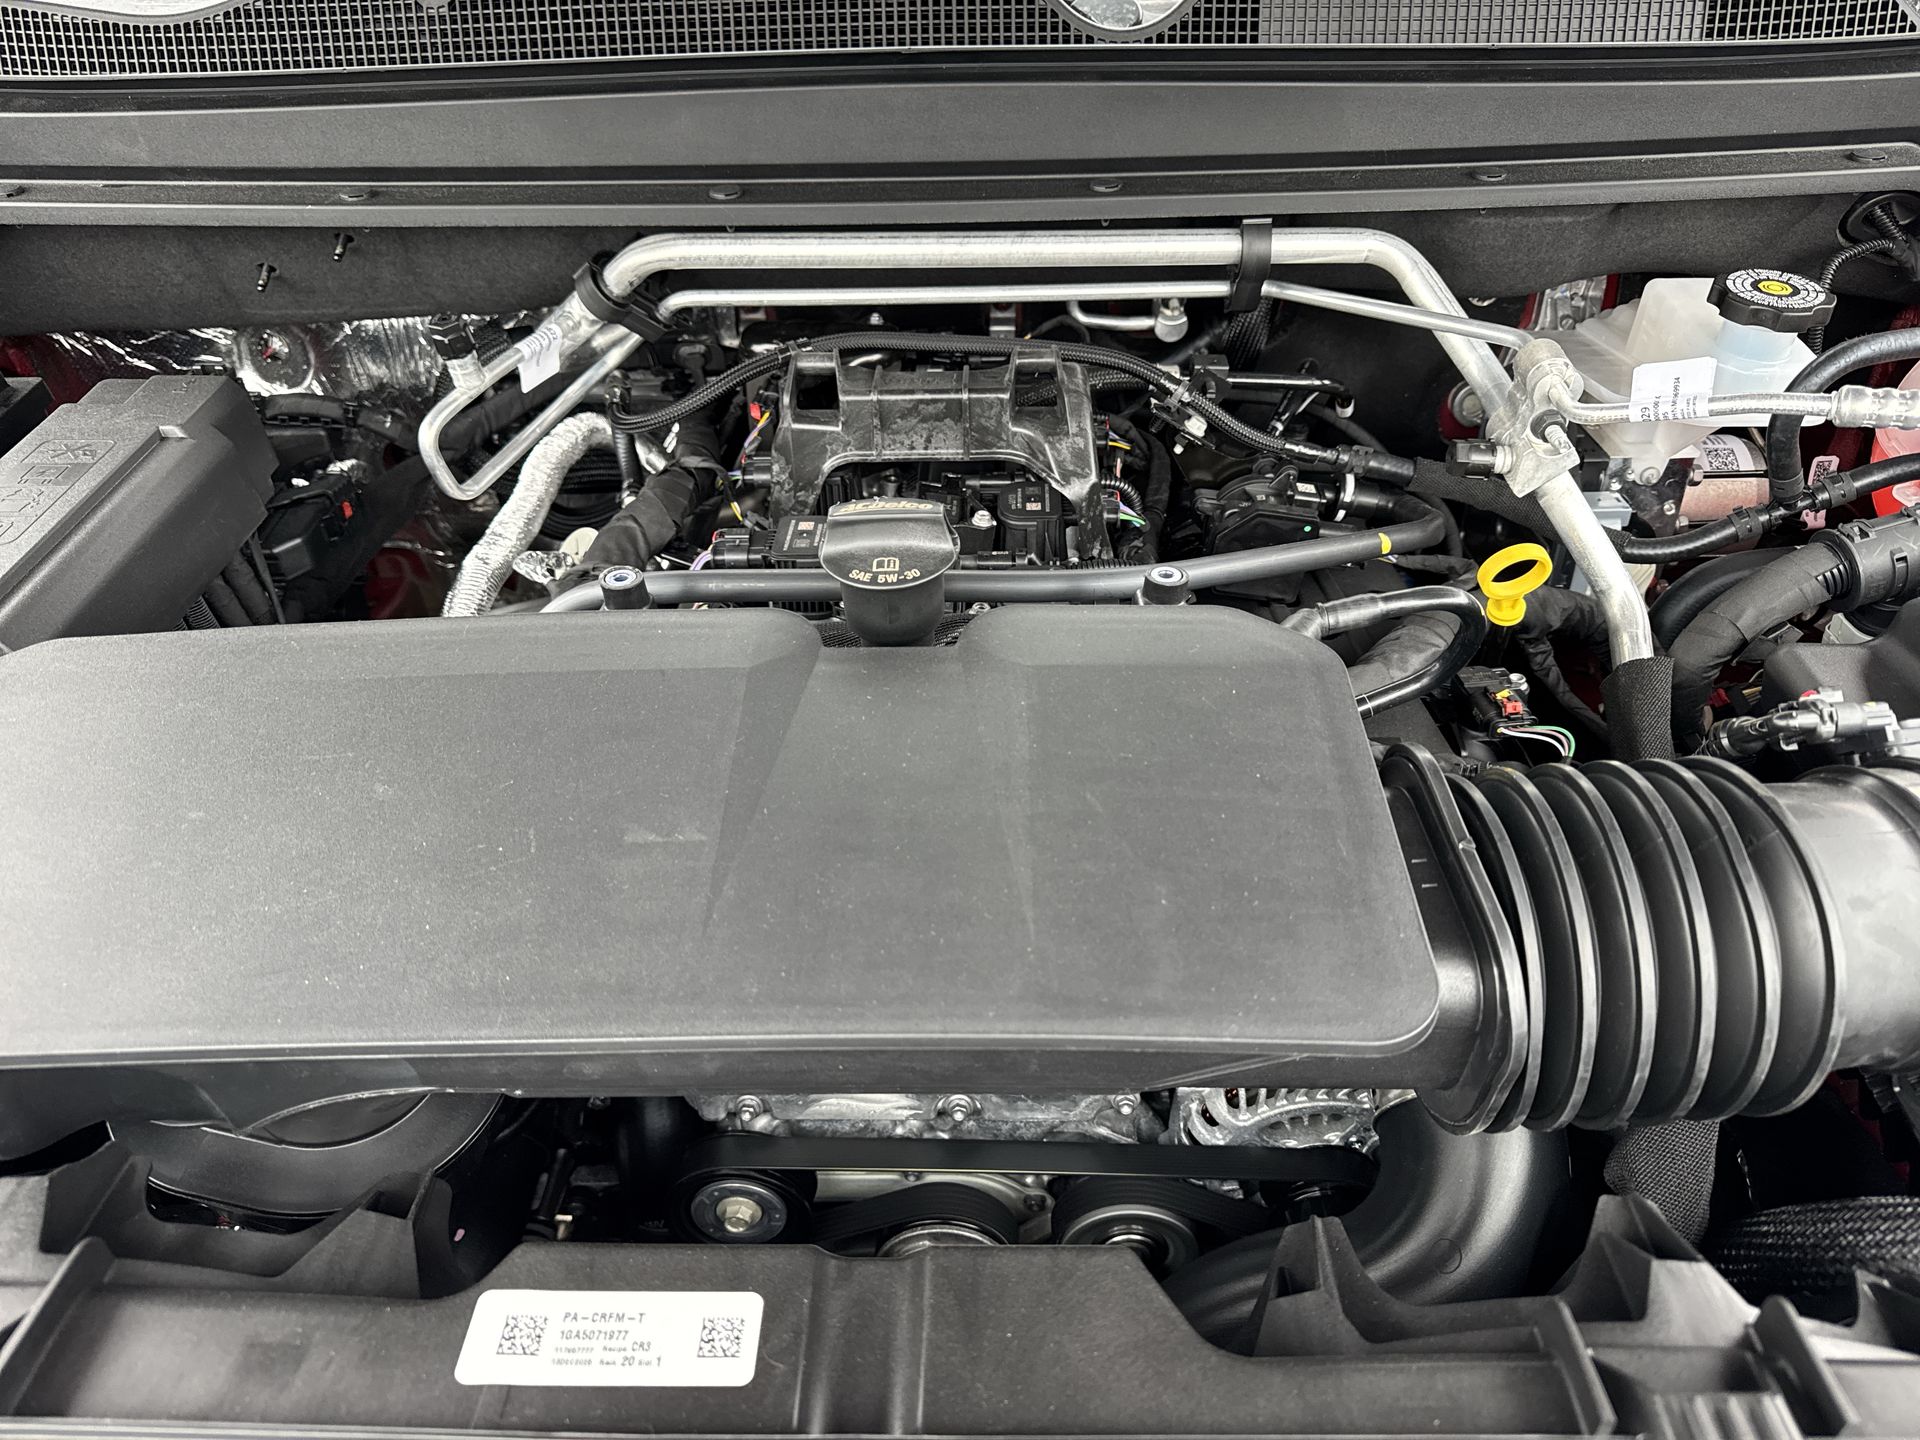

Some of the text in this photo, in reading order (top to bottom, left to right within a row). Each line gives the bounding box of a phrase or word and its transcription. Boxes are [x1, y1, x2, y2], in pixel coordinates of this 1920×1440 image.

[839, 501, 934, 512] ACDelco
[849, 568, 921, 584] SAE 5W-30
[631, 1341, 652, 1352] CR3
[620, 1355, 636, 1367] 20
[656, 1355, 662, 1368] 1
